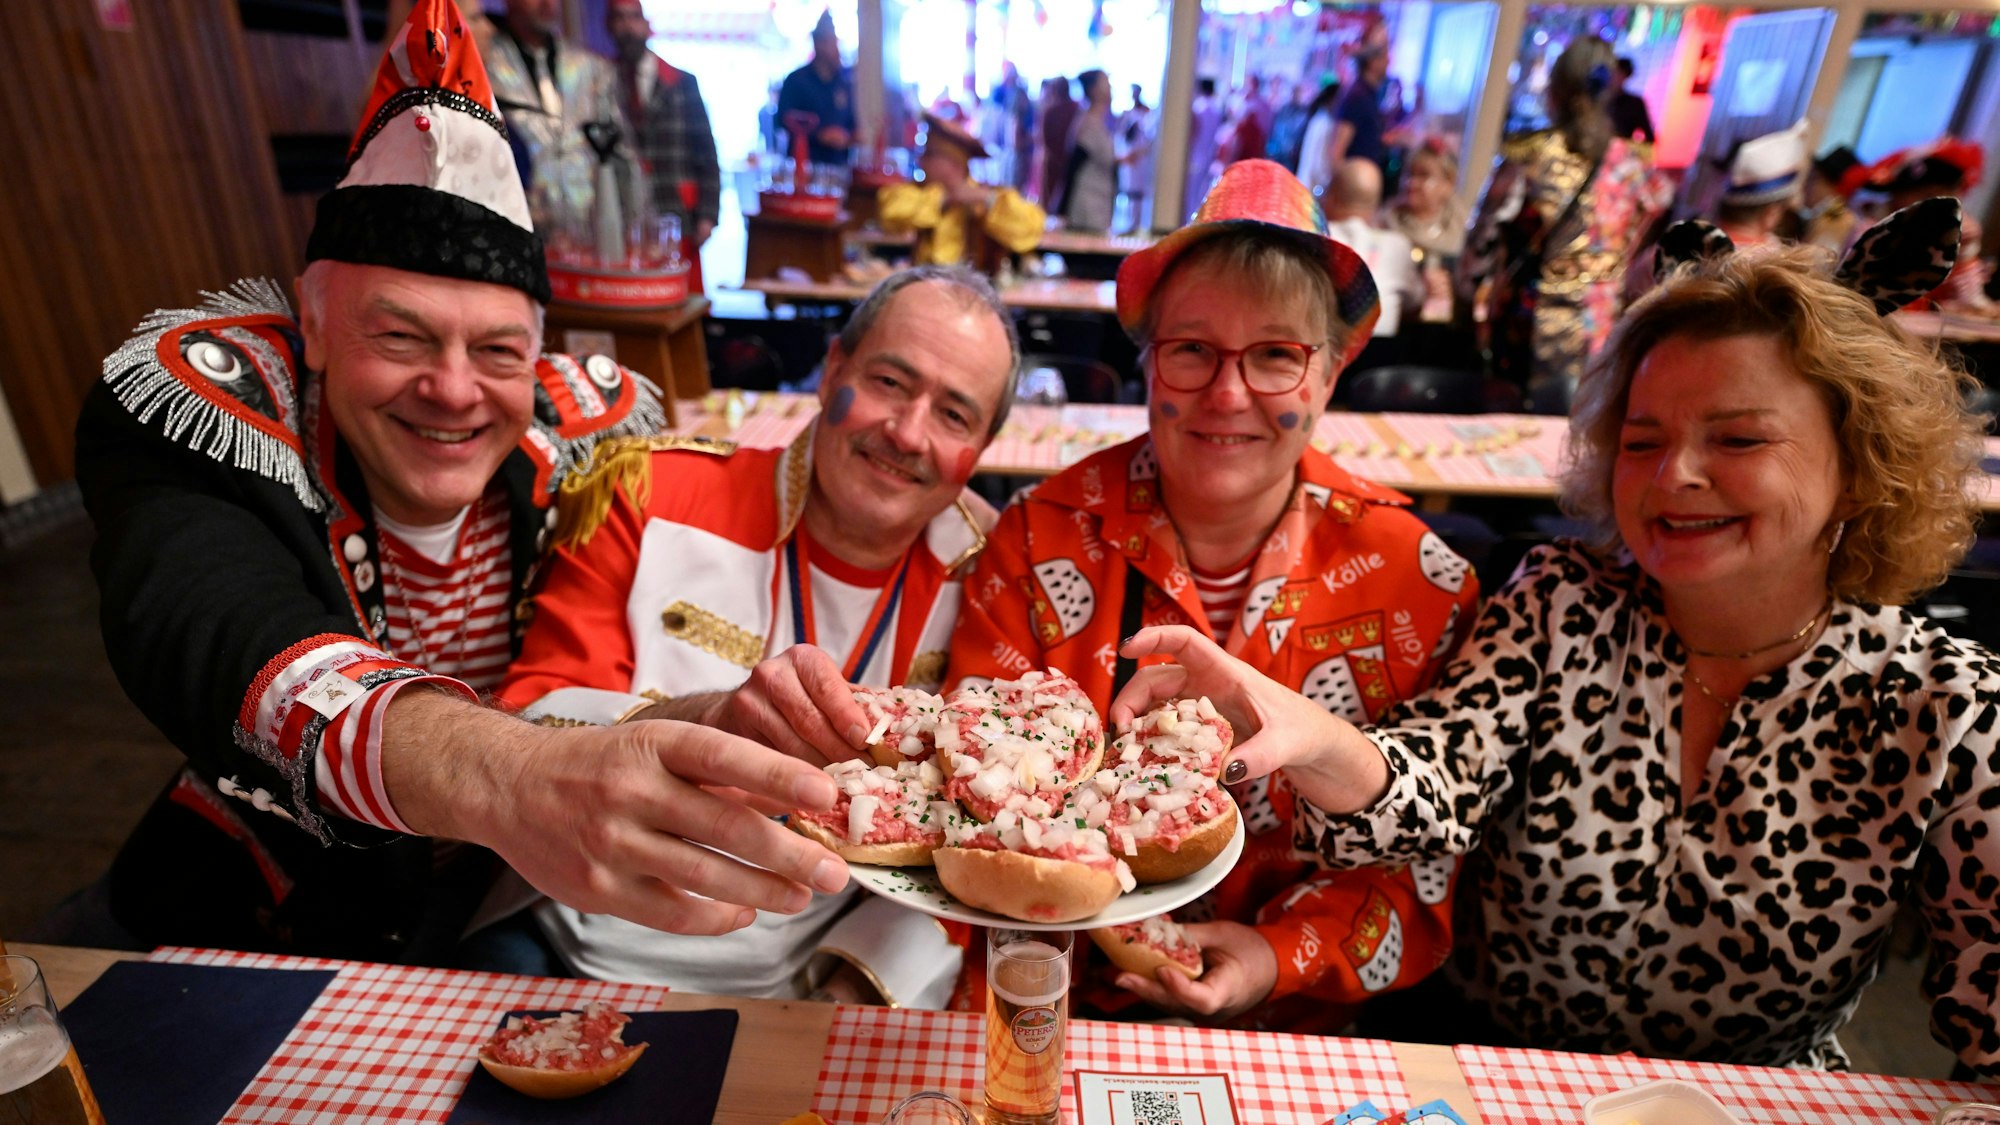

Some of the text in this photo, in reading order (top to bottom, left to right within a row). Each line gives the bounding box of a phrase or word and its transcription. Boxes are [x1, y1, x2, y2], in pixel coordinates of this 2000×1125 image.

[1321, 552, 1386, 594] Kölle
[991, 641, 1032, 675] ölle
[1292, 922, 1322, 975] Köll
[1016, 1022, 1055, 1036] PETERS
